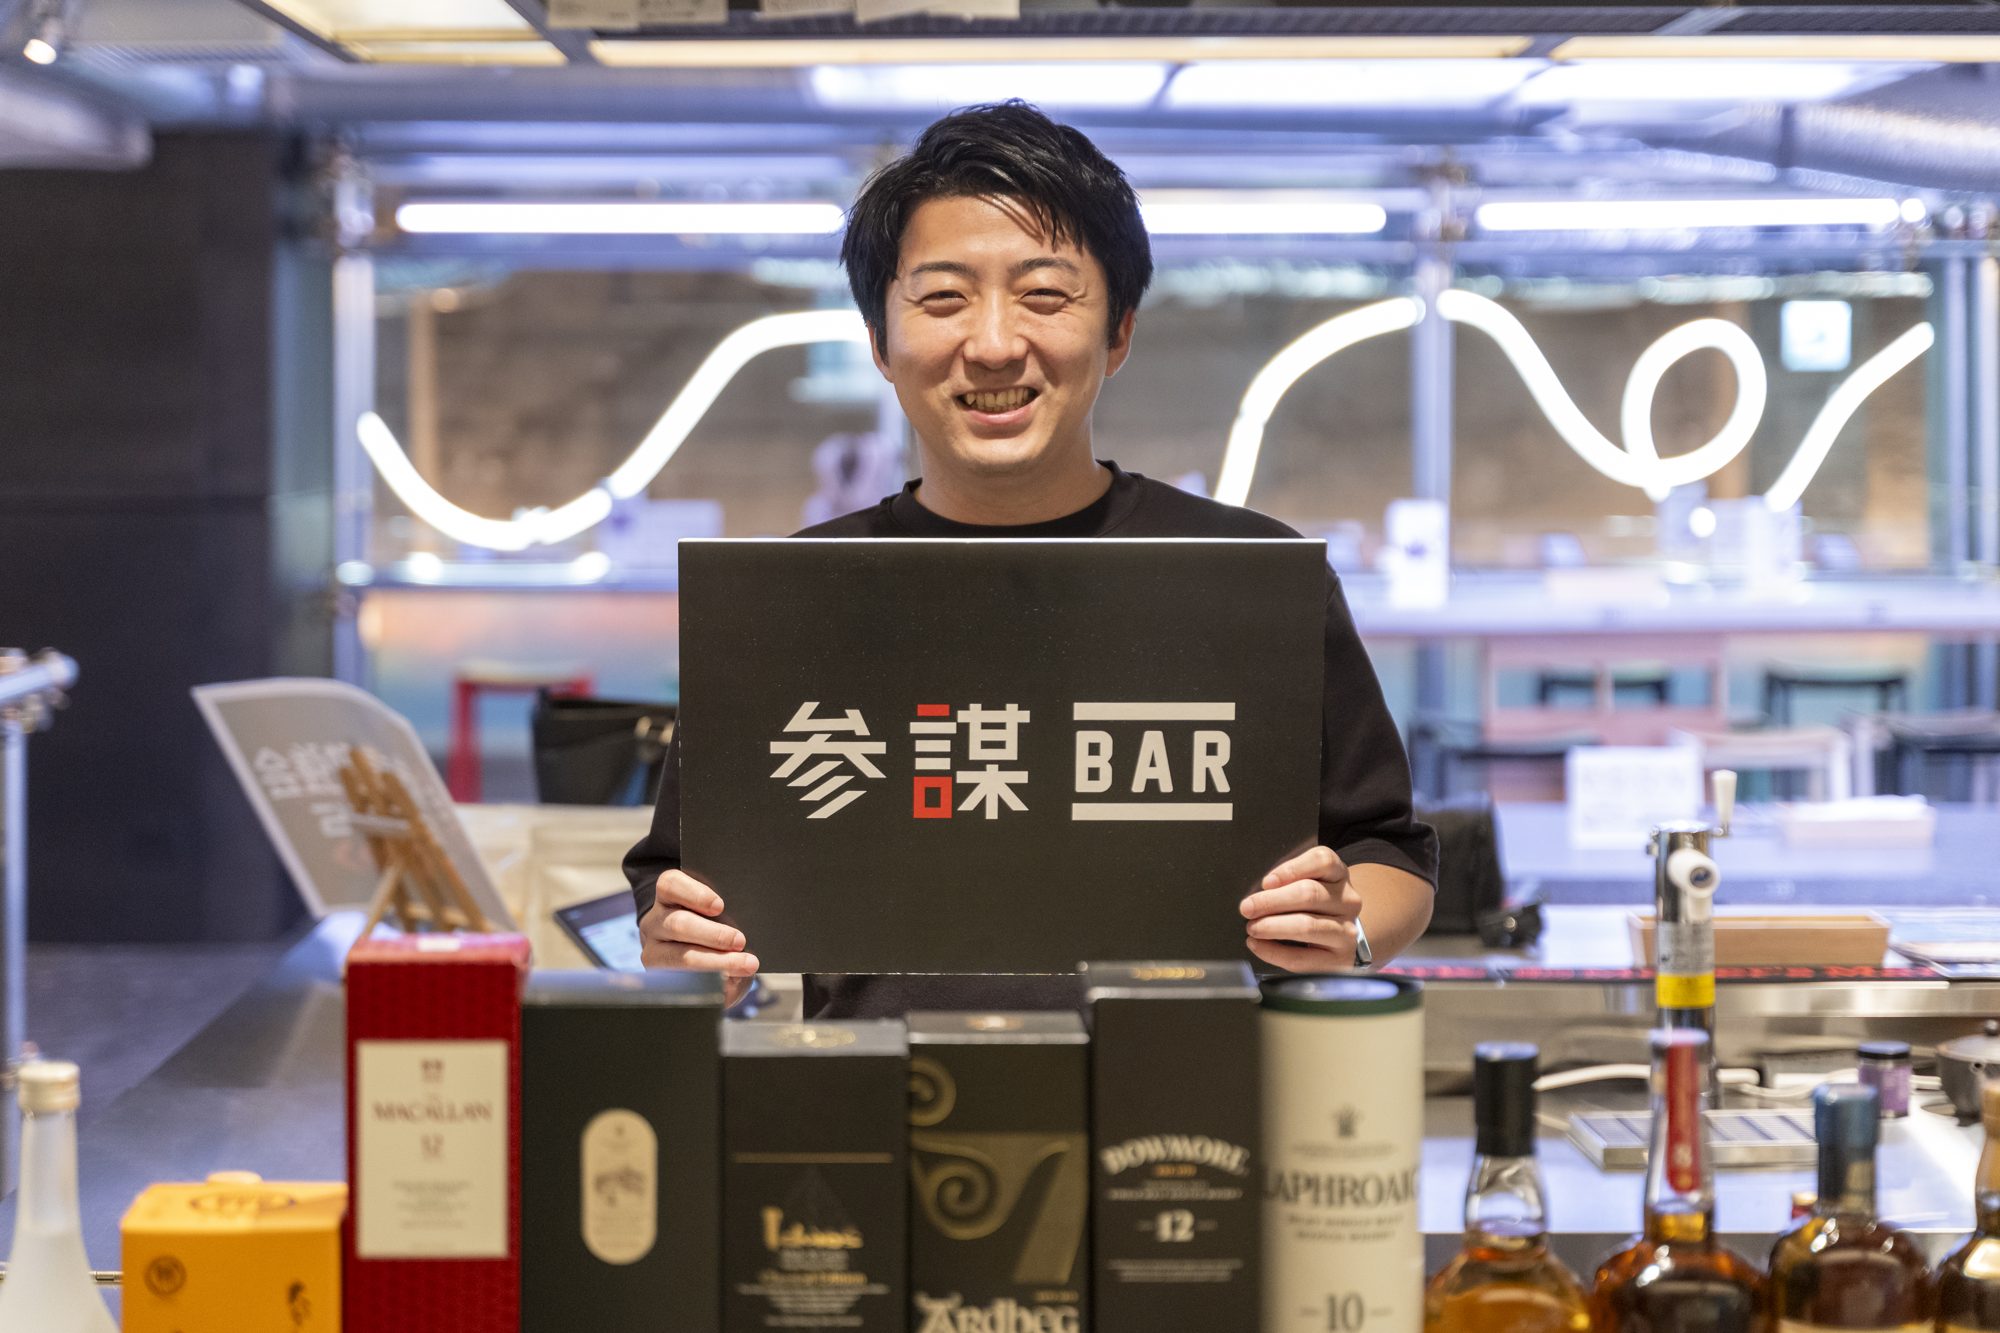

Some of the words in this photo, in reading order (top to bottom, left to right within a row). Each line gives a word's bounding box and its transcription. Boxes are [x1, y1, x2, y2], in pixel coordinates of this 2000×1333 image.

[769, 701, 1030, 820] 参謀
[1074, 730, 1231, 793] BAR
[1101, 1134, 1250, 1175] BOWMORE
[1155, 1208, 1195, 1243] 12
[1326, 1292, 1365, 1333] 10
